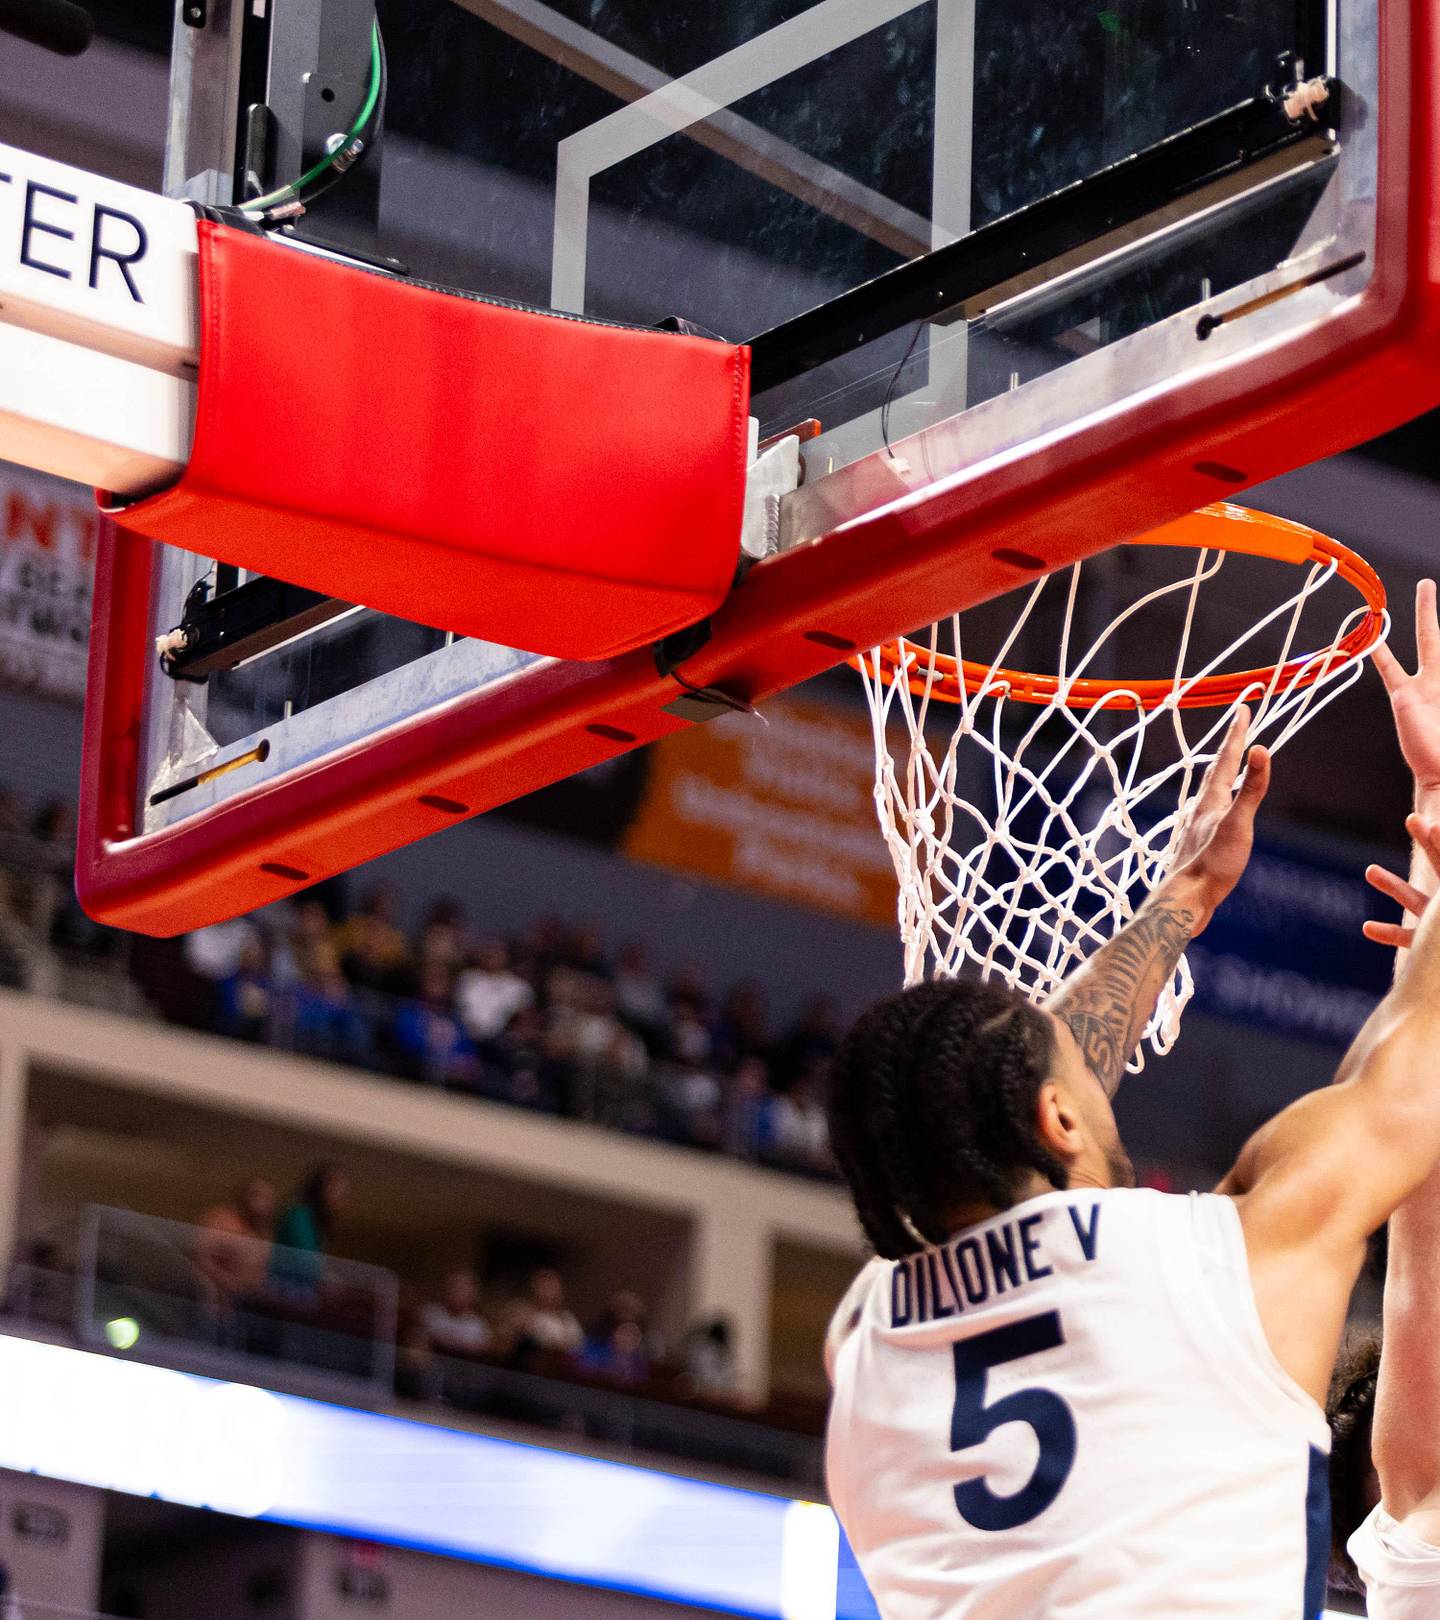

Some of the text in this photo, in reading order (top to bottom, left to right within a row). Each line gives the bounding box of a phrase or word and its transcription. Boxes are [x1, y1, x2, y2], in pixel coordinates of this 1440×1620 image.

[0, 171, 148, 304] ER
[891, 1203, 1100, 1328] DILIONE V
[950, 1309, 1078, 1531] 5
